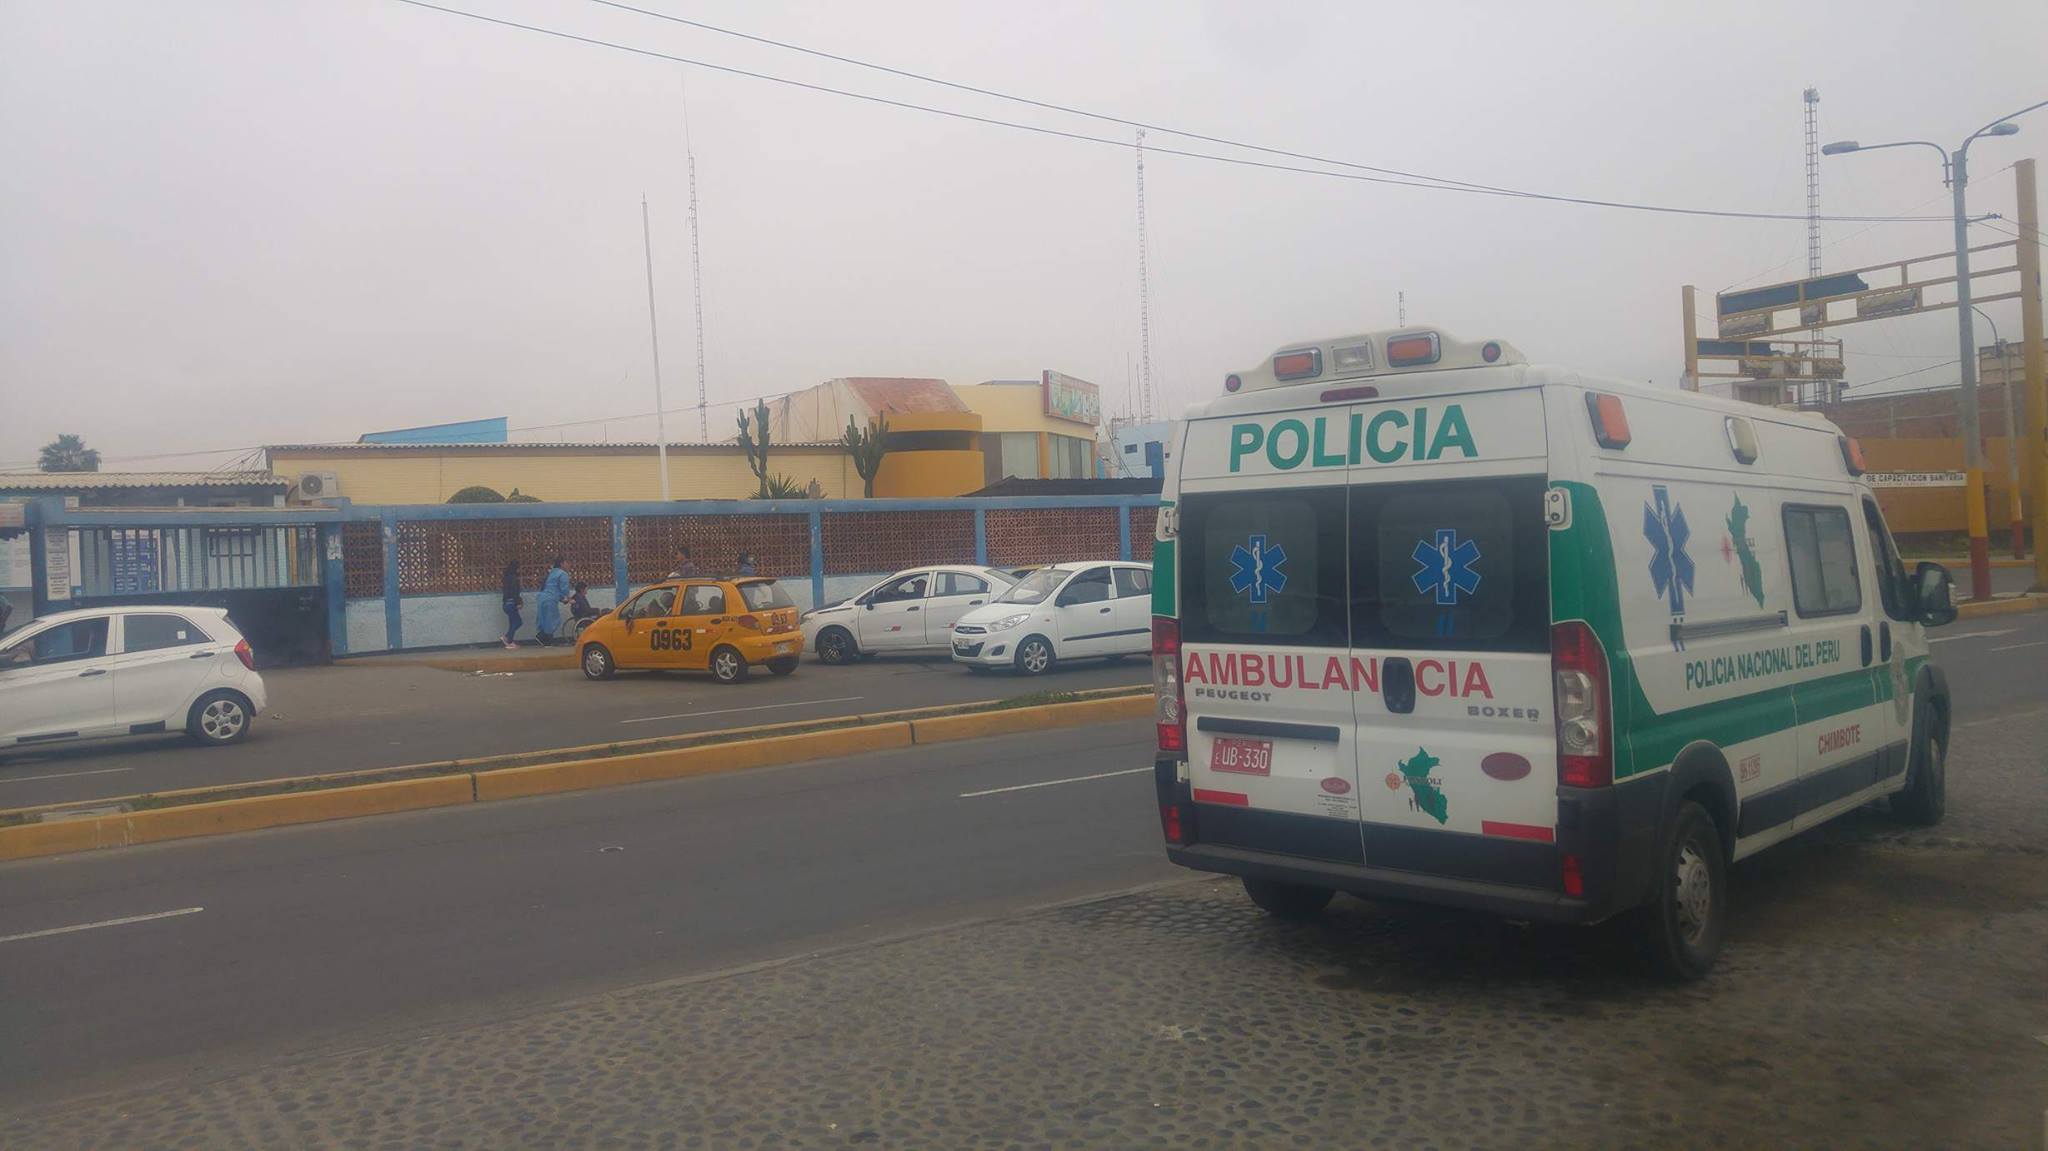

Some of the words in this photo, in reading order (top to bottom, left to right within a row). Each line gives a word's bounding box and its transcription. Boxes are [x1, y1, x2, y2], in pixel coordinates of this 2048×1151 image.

[1230, 404, 1478, 472] POLICIA
[650, 629, 692, 651] 0963
[1686, 656, 1736, 691] POLICIA
[1738, 647, 1793, 680] NACIONAL
[1796, 643, 1815, 669] DEL
[1816, 640, 1840, 665] PERU
[1195, 688, 1272, 702] PEUGEOT
[1467, 706, 1540, 720] BOXER
[1818, 724, 1861, 755] CHIMBOTE
[1222, 746, 1268, 769] UB-330
